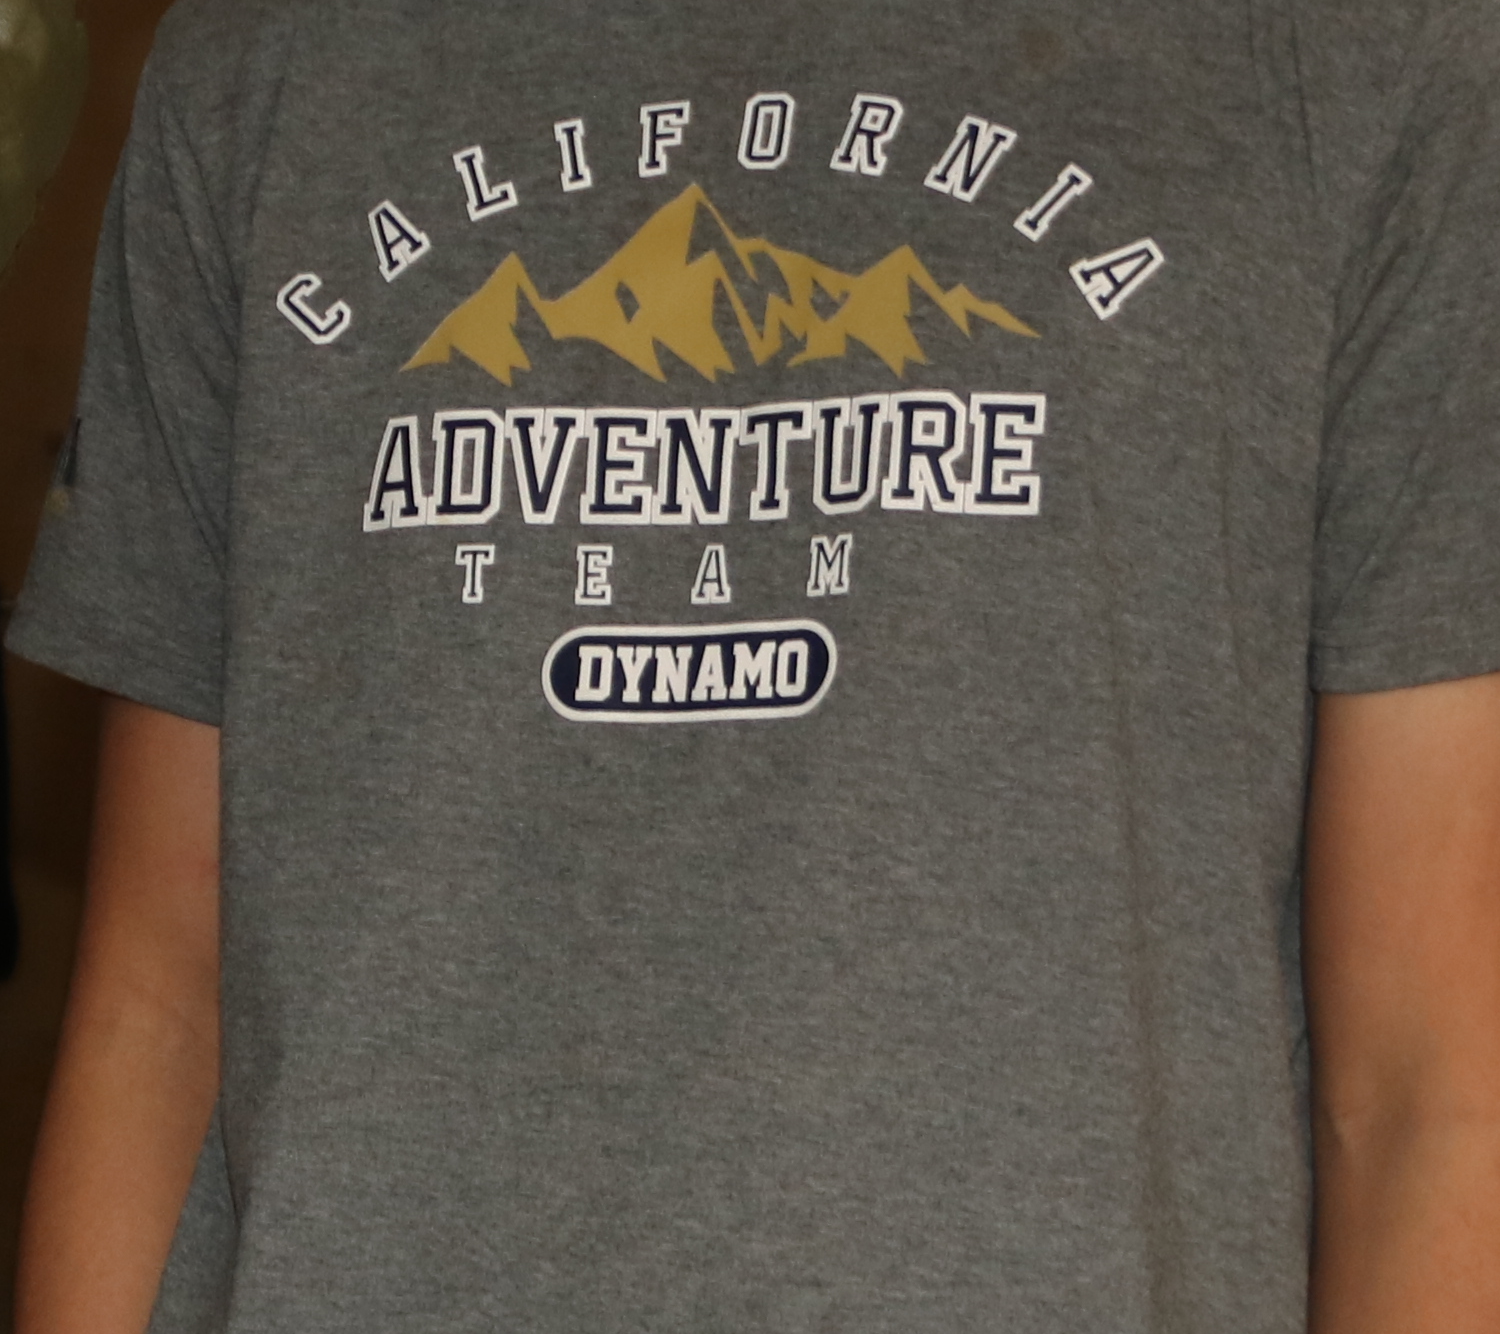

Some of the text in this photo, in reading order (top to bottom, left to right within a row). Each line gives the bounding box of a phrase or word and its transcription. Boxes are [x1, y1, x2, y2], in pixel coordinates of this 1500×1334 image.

[276, 92, 1164, 344] CALIFORNIA
[363, 391, 1046, 532] ADVENTURE
[455, 533, 853, 605] TEAM
[574, 637, 810, 704] DYNAMO
